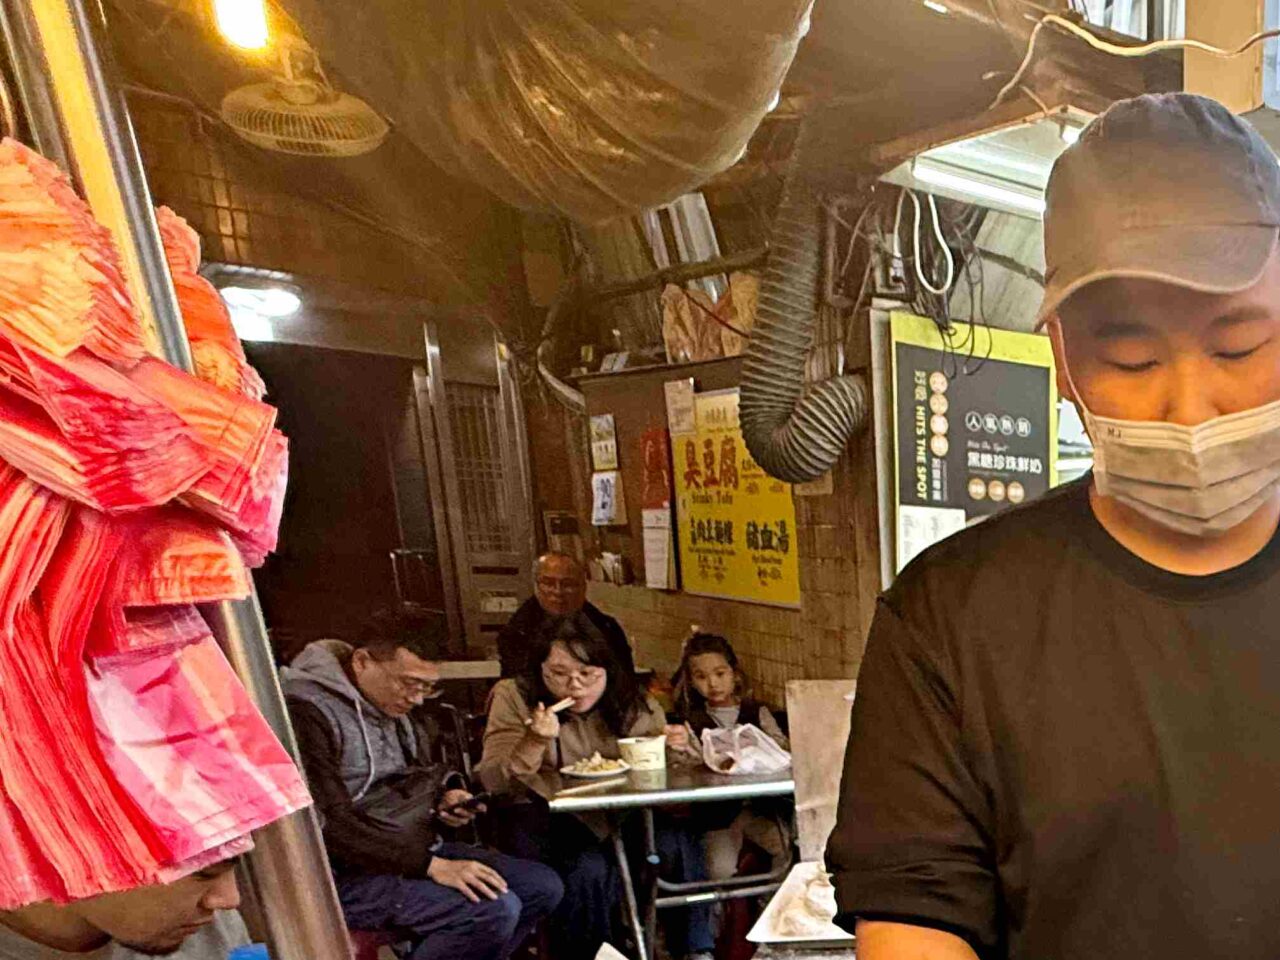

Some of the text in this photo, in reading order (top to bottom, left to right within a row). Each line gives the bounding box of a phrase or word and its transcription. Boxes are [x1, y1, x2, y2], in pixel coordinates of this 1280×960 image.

[915, 405, 926, 435] HITS
[684, 434, 739, 491] 臭豆腐
[916, 438, 927, 464] THE
[916, 465, 928, 500] SPOT
